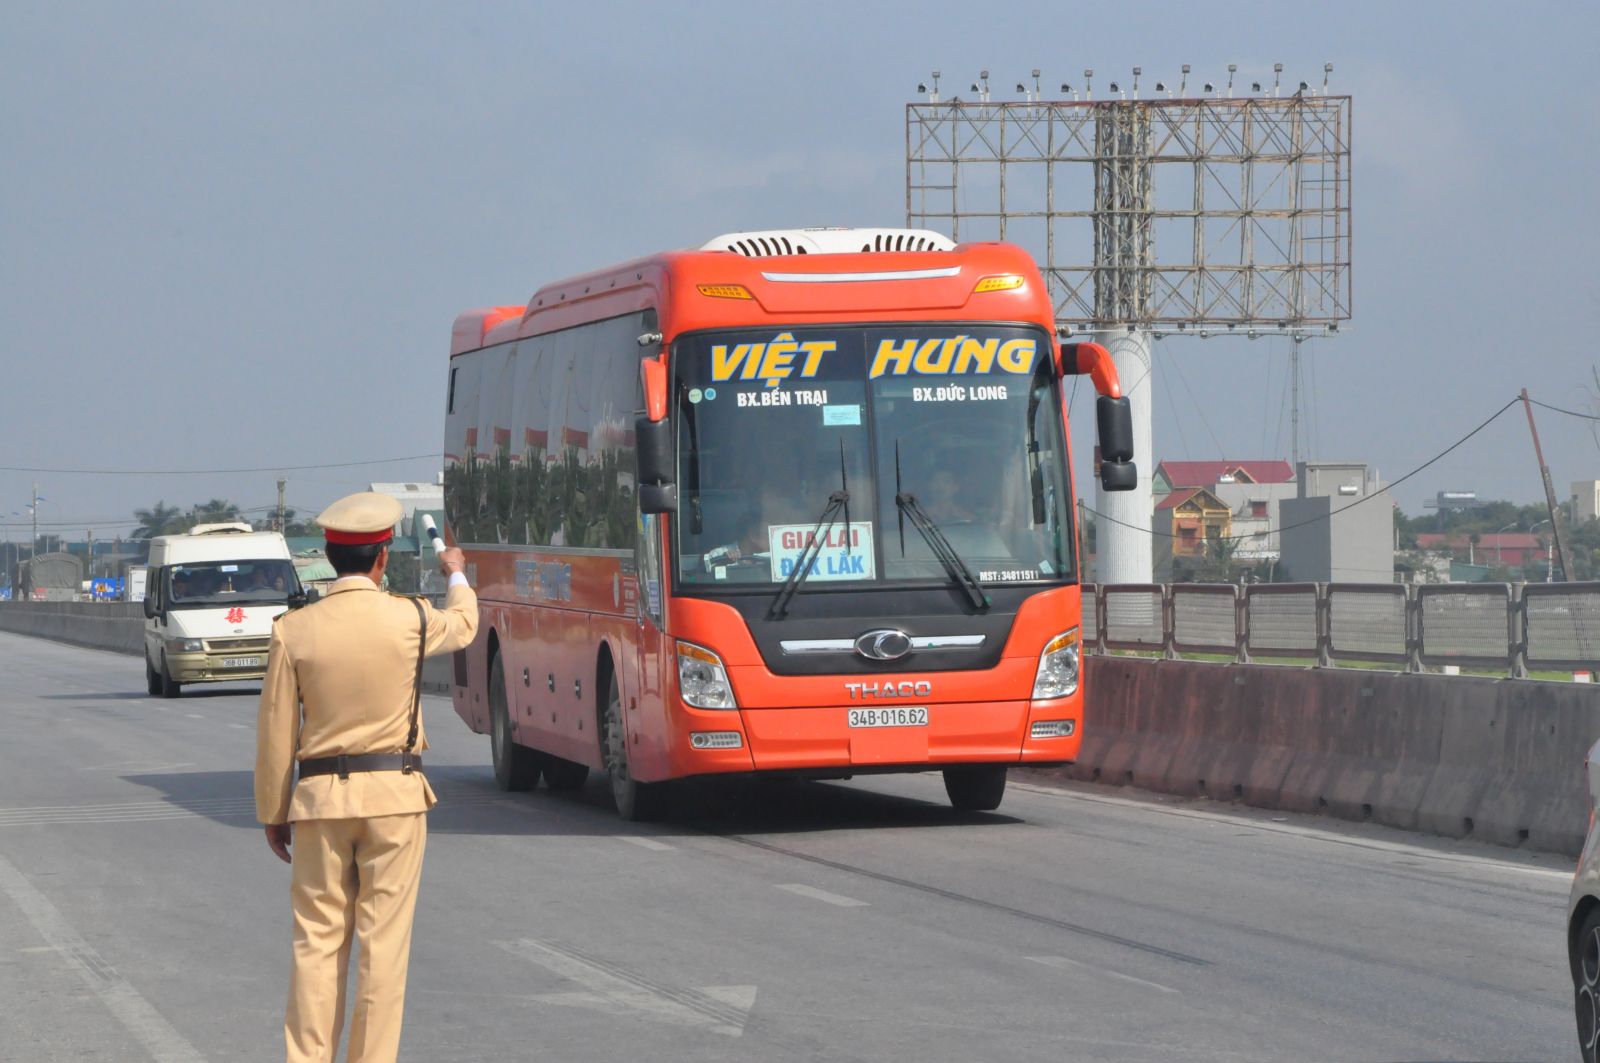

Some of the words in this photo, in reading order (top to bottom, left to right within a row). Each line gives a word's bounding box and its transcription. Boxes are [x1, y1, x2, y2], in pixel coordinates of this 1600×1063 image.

[711, 332, 837, 388] VIỆT
[868, 334, 1037, 380] HƯNG
[737, 388, 791, 407] BX.BẾN
[795, 390, 827, 407] TRẠI
[913, 383, 966, 402] BX.ĐỨC
[970, 386, 1008, 400] LONG
[781, 530, 818, 550] GIA
[826, 529, 859, 548] LAI
[844, 680, 932, 699] THACO
[850, 708, 926, 726] 34B-016.62
